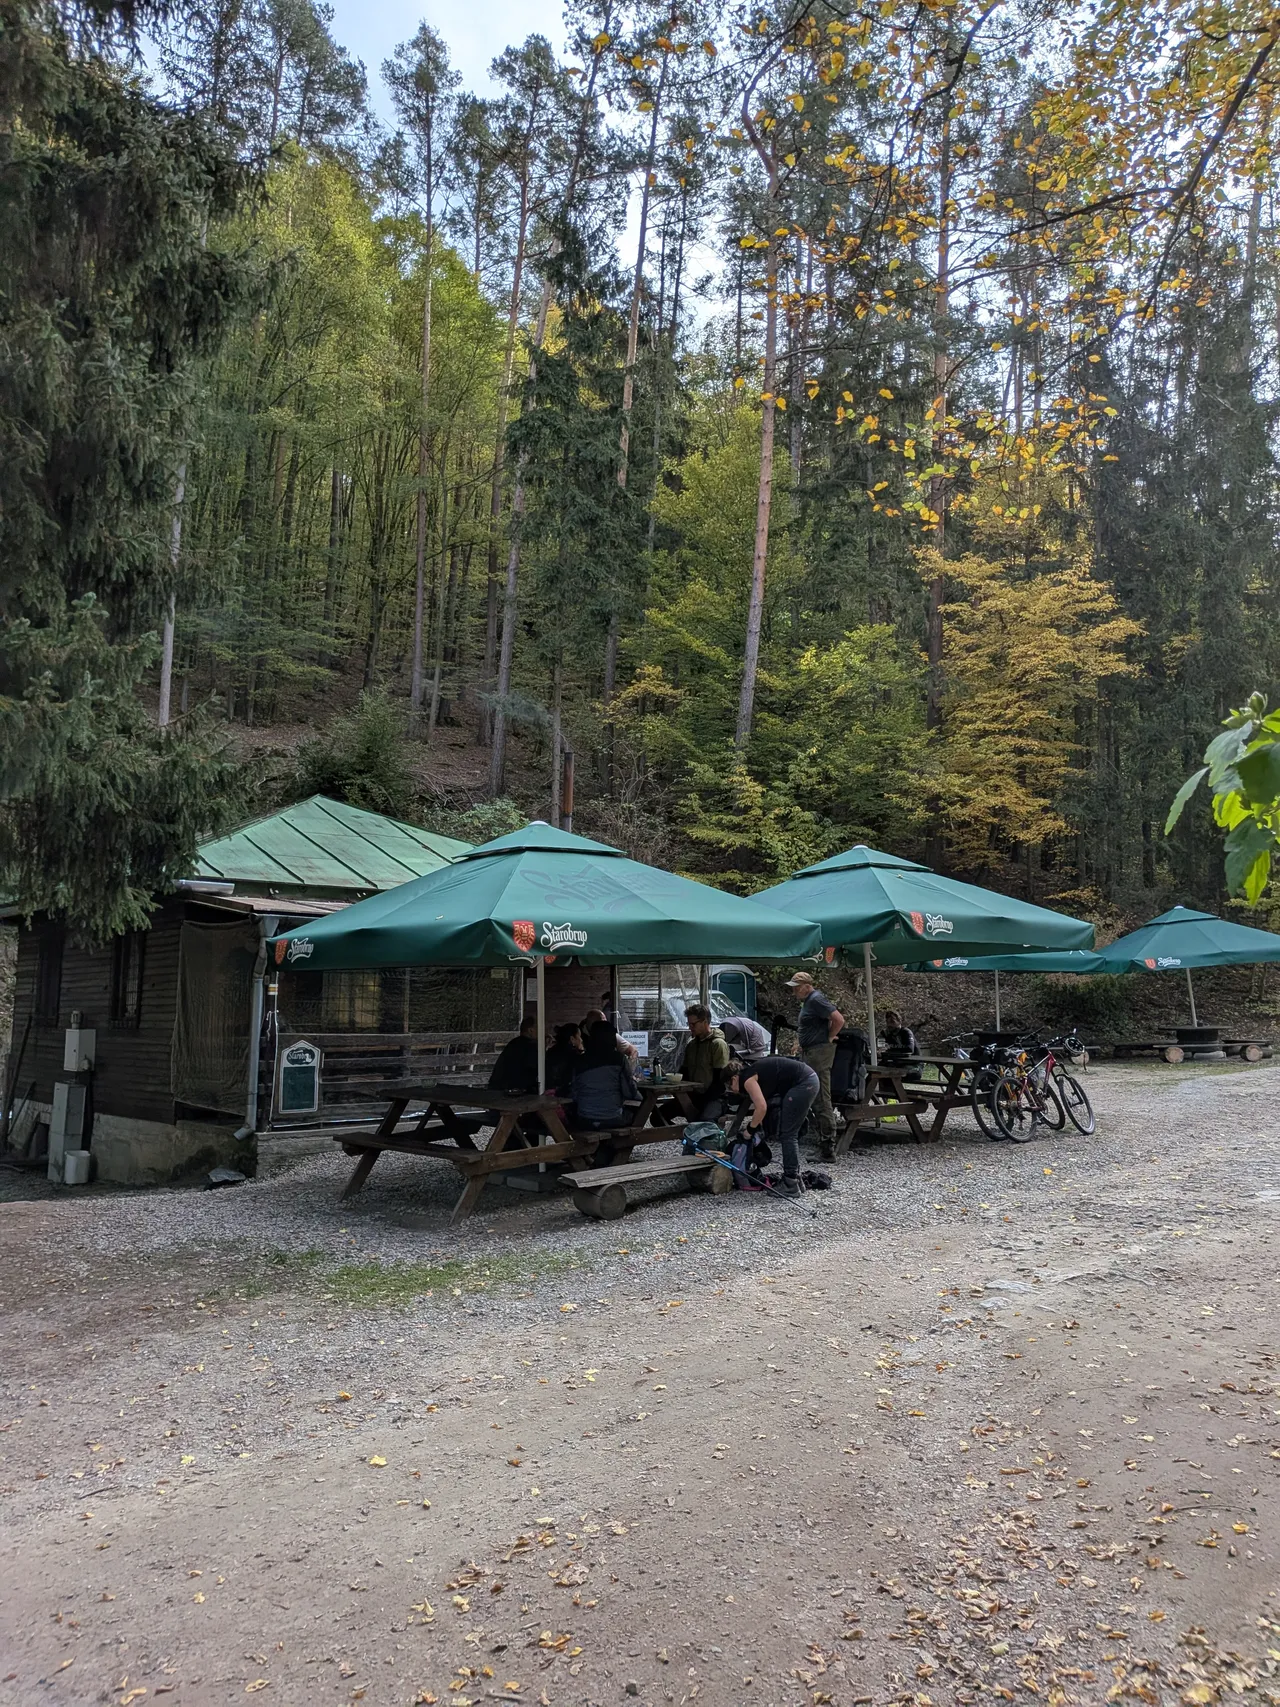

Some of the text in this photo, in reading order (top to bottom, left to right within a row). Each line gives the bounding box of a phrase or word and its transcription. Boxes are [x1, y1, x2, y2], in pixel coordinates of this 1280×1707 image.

[540, 921, 588, 952] Starobrno
[925, 913, 954, 936] Starobrno
[286, 937, 314, 964] Starobrno
